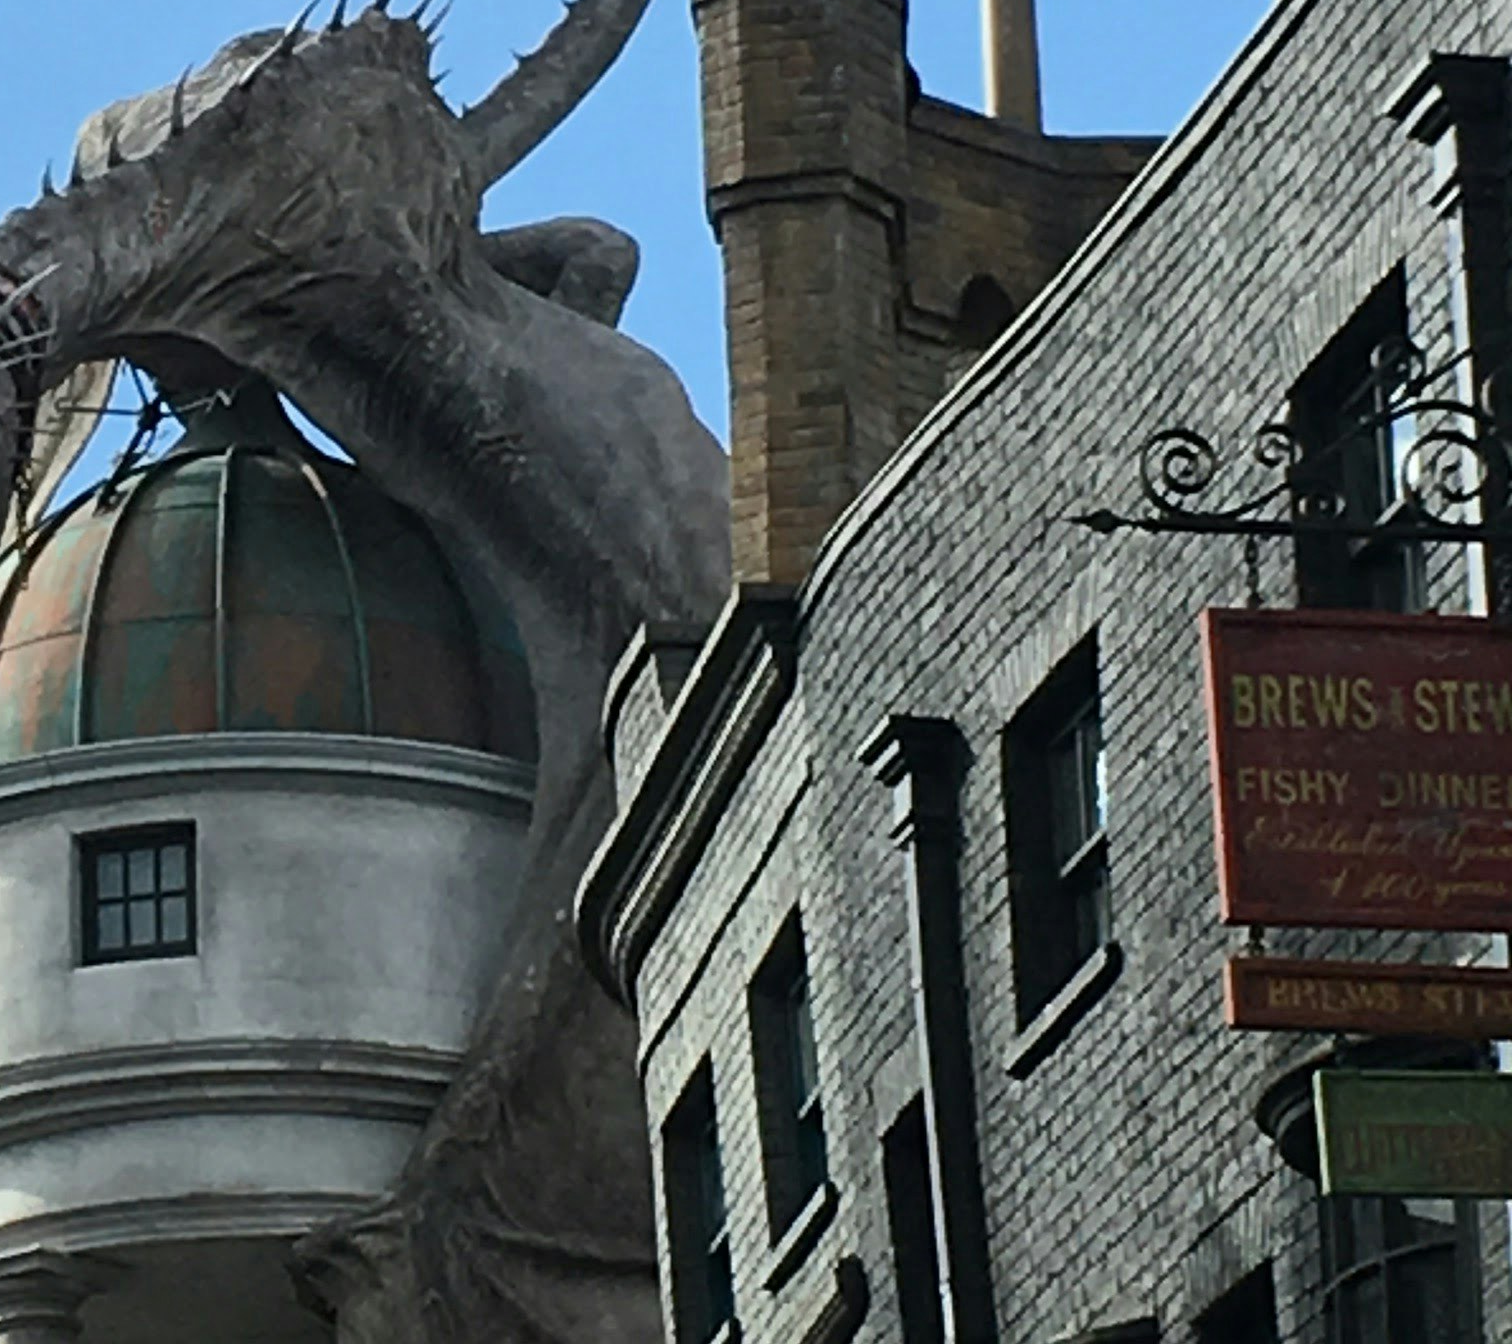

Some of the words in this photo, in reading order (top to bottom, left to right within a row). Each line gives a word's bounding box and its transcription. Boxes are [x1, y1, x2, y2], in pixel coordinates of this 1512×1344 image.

[1231, 672, 1378, 732] BREWS
[1236, 766, 1351, 807] FISHY
[1377, 768, 1512, 811] DINNE
